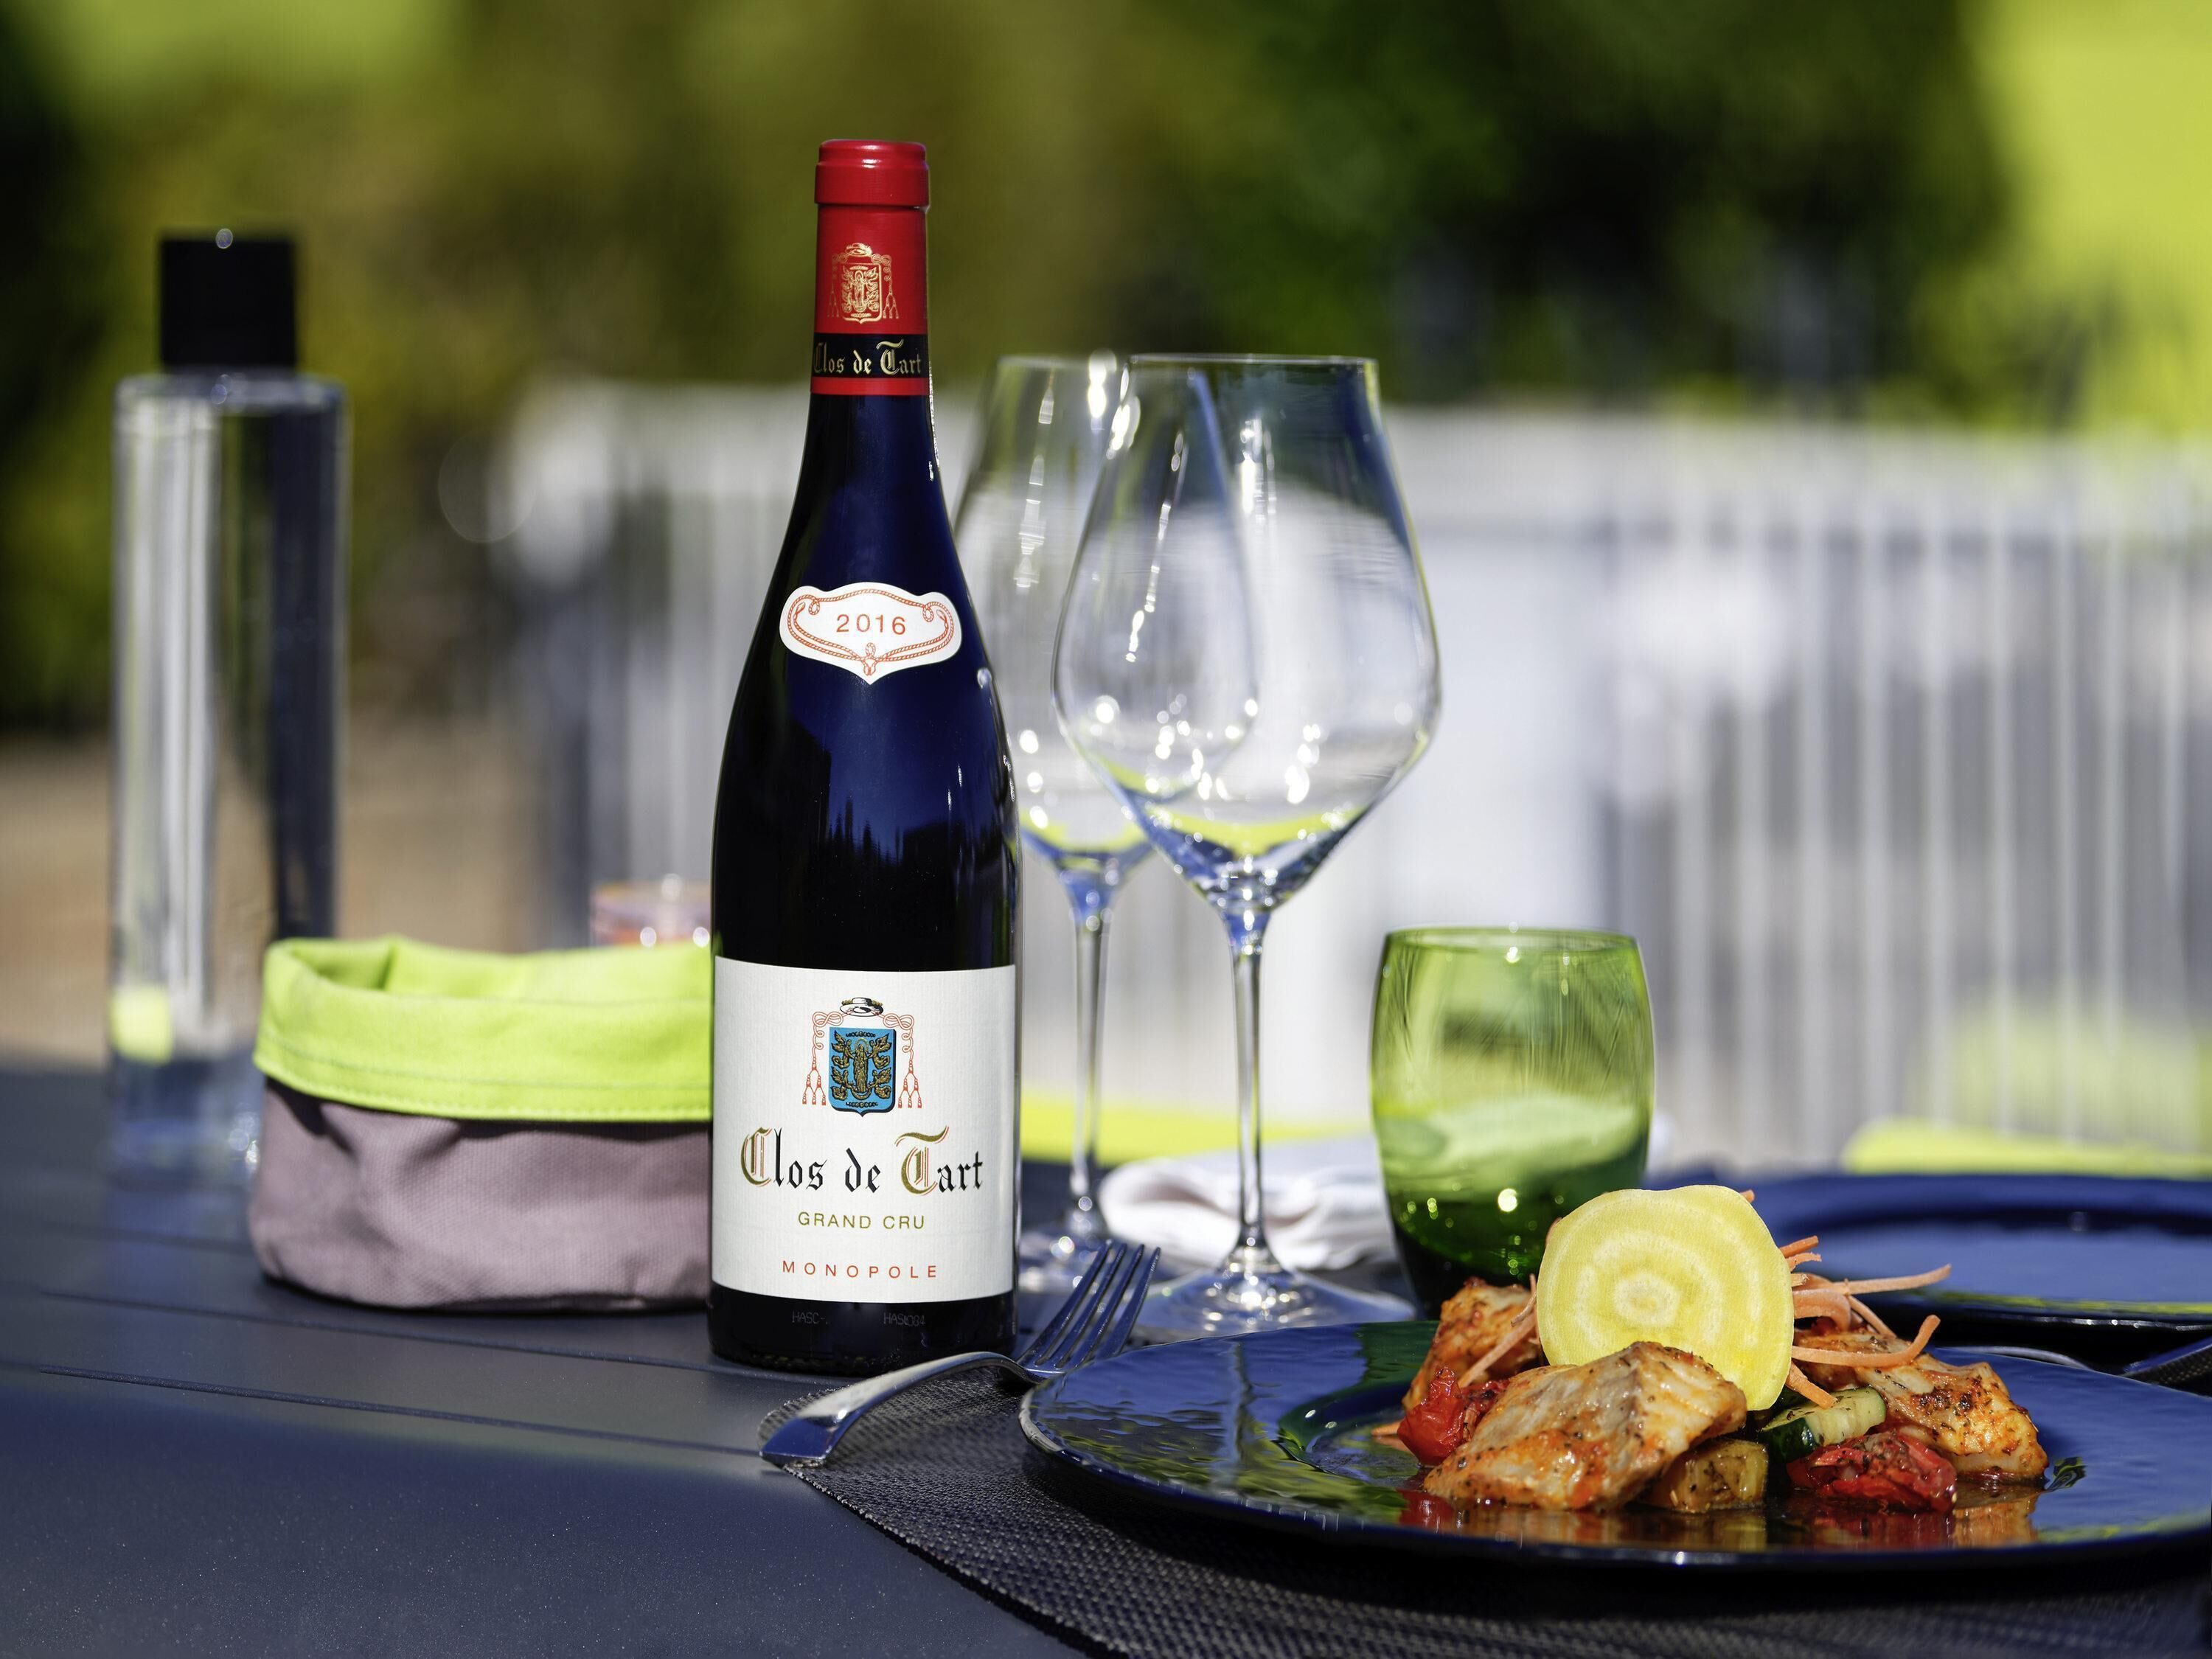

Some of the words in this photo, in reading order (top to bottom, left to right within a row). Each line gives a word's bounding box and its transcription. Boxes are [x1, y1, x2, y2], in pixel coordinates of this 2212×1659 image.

[813, 341, 846, 374] Clos
[853, 349, 872, 375] de
[876, 338, 922, 375] Tart
[836, 613, 906, 635] 2016
[740, 1127, 827, 1191] Clos
[845, 1147, 881, 1193] de
[895, 1125, 984, 1196] Tart
[798, 1211, 872, 1230] GRAND
[883, 1214, 926, 1230] CRU
[782, 1260, 937, 1279] MONOPOLE
